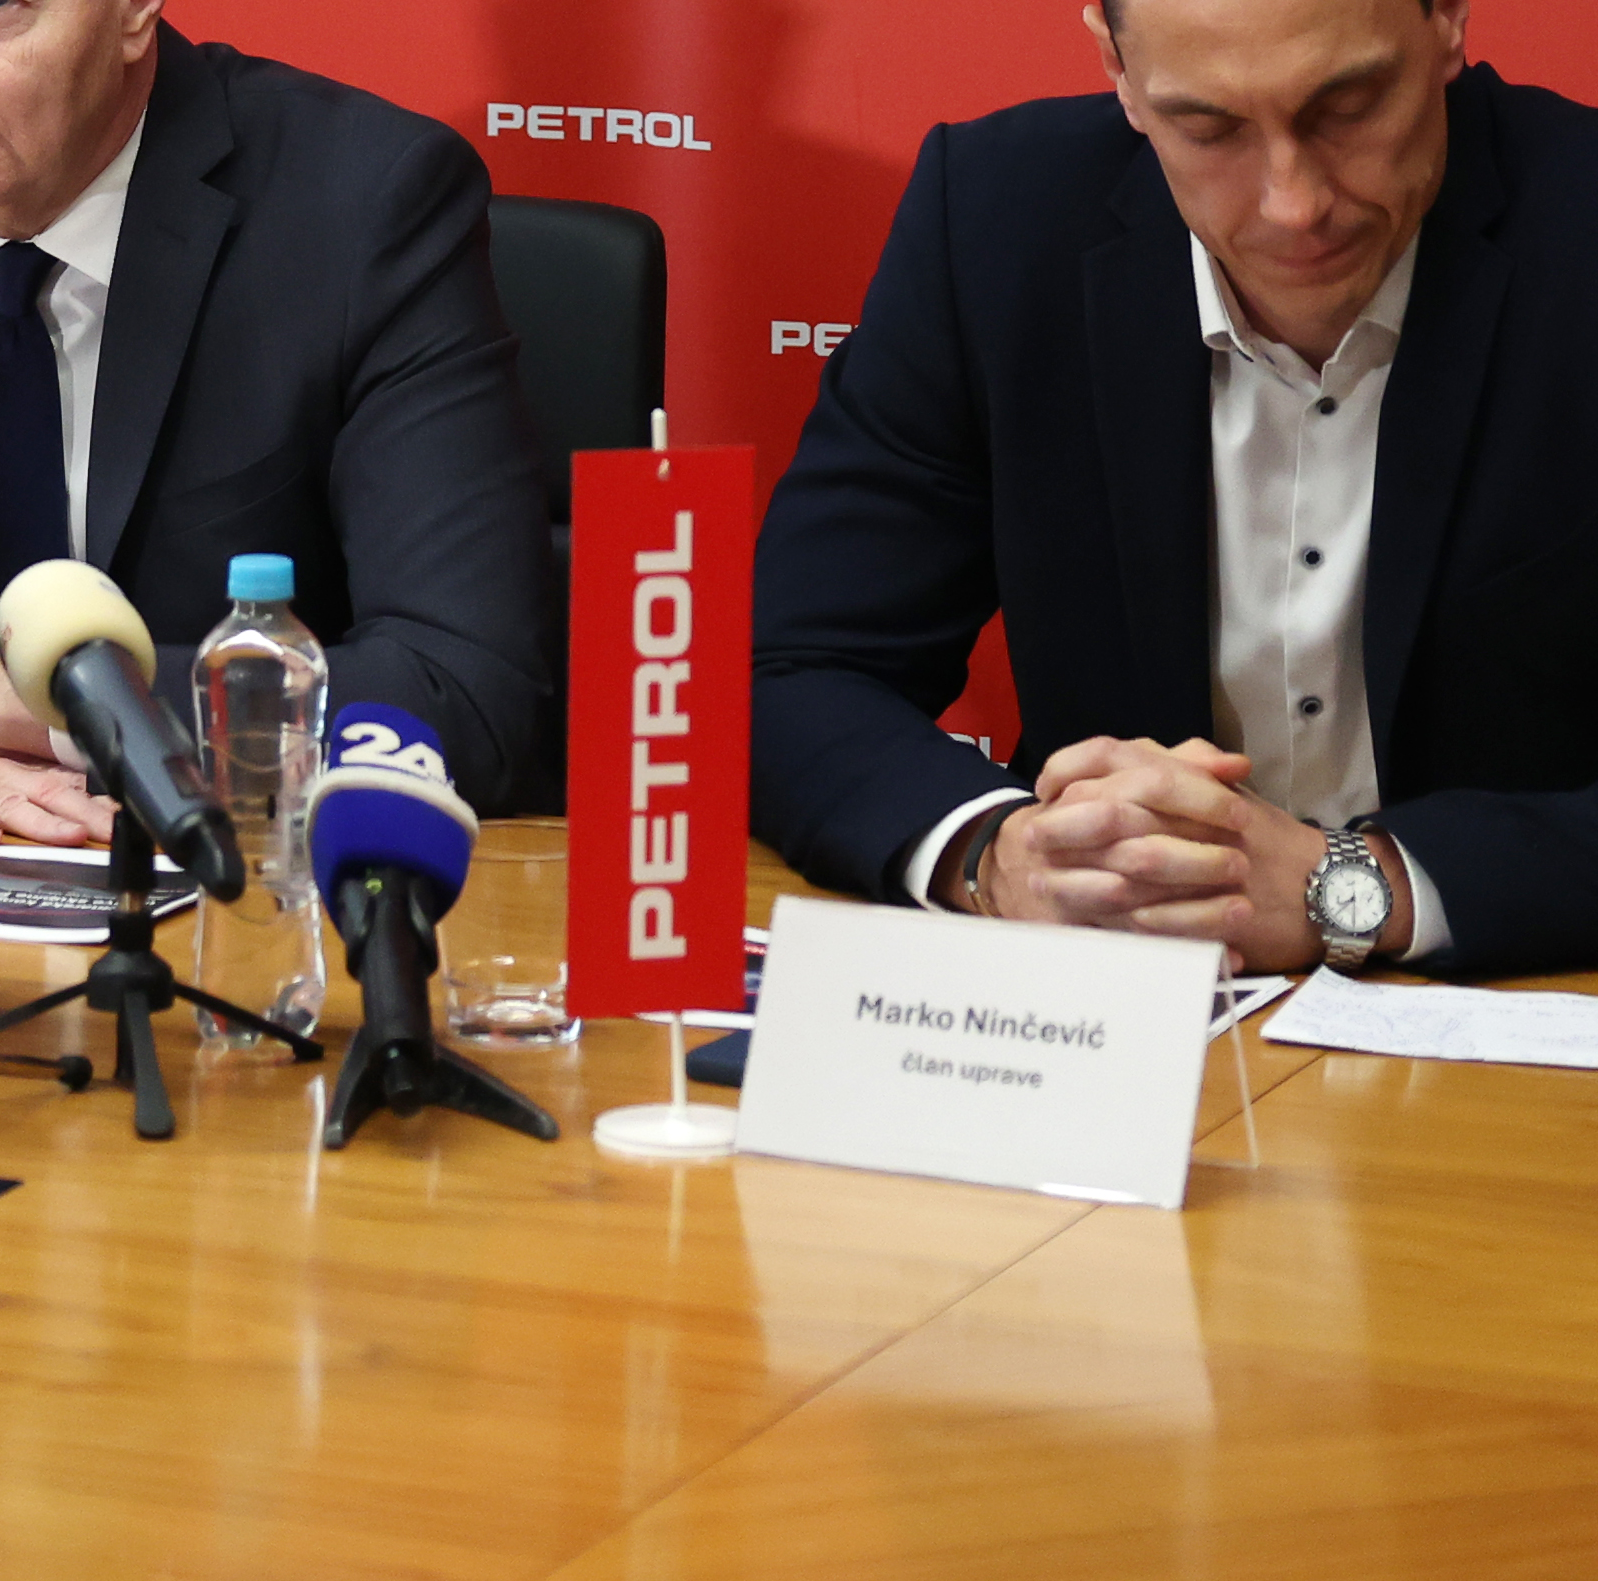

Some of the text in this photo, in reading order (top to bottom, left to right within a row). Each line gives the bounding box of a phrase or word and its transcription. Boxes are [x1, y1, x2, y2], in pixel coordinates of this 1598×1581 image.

[488, 103, 711, 150] PETROL
[630, 511, 692, 960] PETROL
[857, 993, 1107, 1050] Marko Ninčević
[901, 1050, 1044, 1089] član uprave
